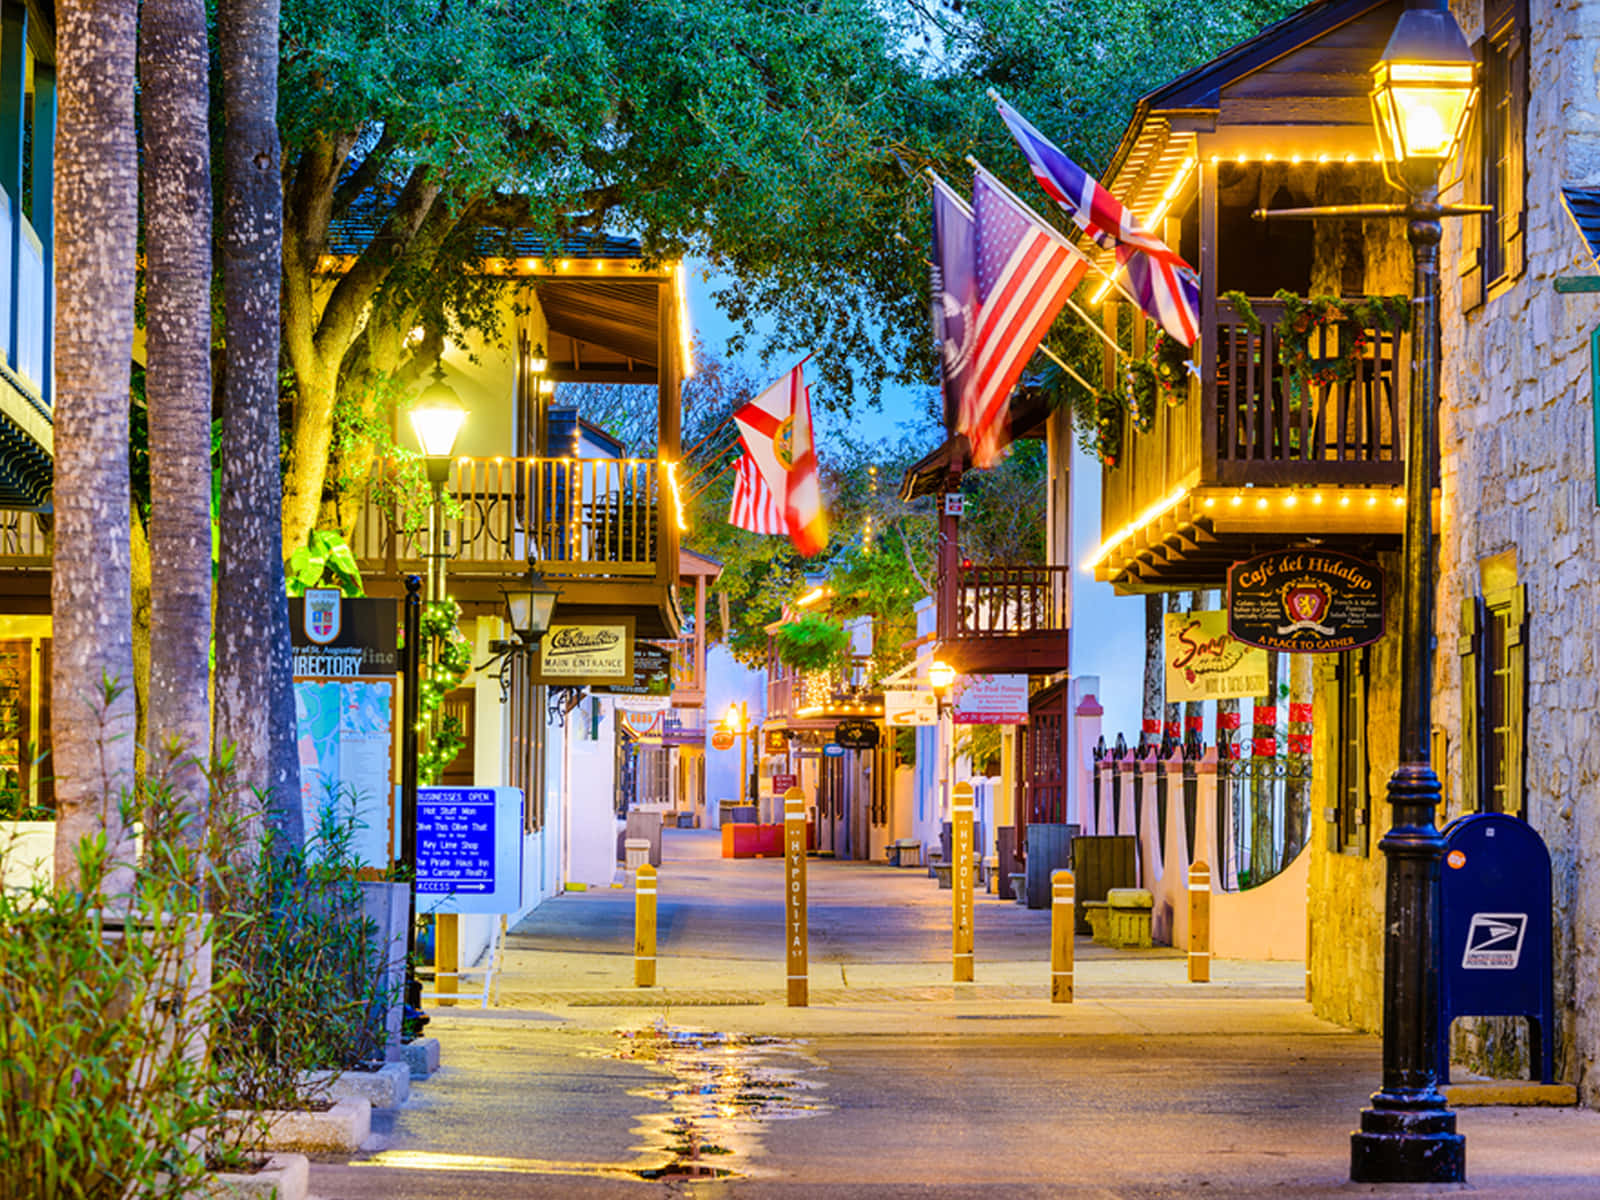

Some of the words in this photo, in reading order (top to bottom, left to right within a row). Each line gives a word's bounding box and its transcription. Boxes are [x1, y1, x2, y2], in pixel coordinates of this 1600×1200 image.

[1238, 557, 1276, 588] Café
[1278, 554, 1304, 573] del
[1307, 556, 1373, 590] Hidalgo
[1258, 635, 1266, 645] A
[1267, 636, 1297, 649] PLACE
[1300, 640, 1314, 650] TO
[1316, 636, 1356, 650] GATHER
[293, 655, 362, 677] IRECTORY
[544, 658, 569, 668] MAIN
[572, 658, 624, 668] ENTRANCE
[468, 792, 490, 801] OPEN
[423, 841, 437, 850] Key
[440, 841, 457, 849] Lime
[461, 841, 479, 850] Shop
[417, 883, 450, 891] ACCESS
